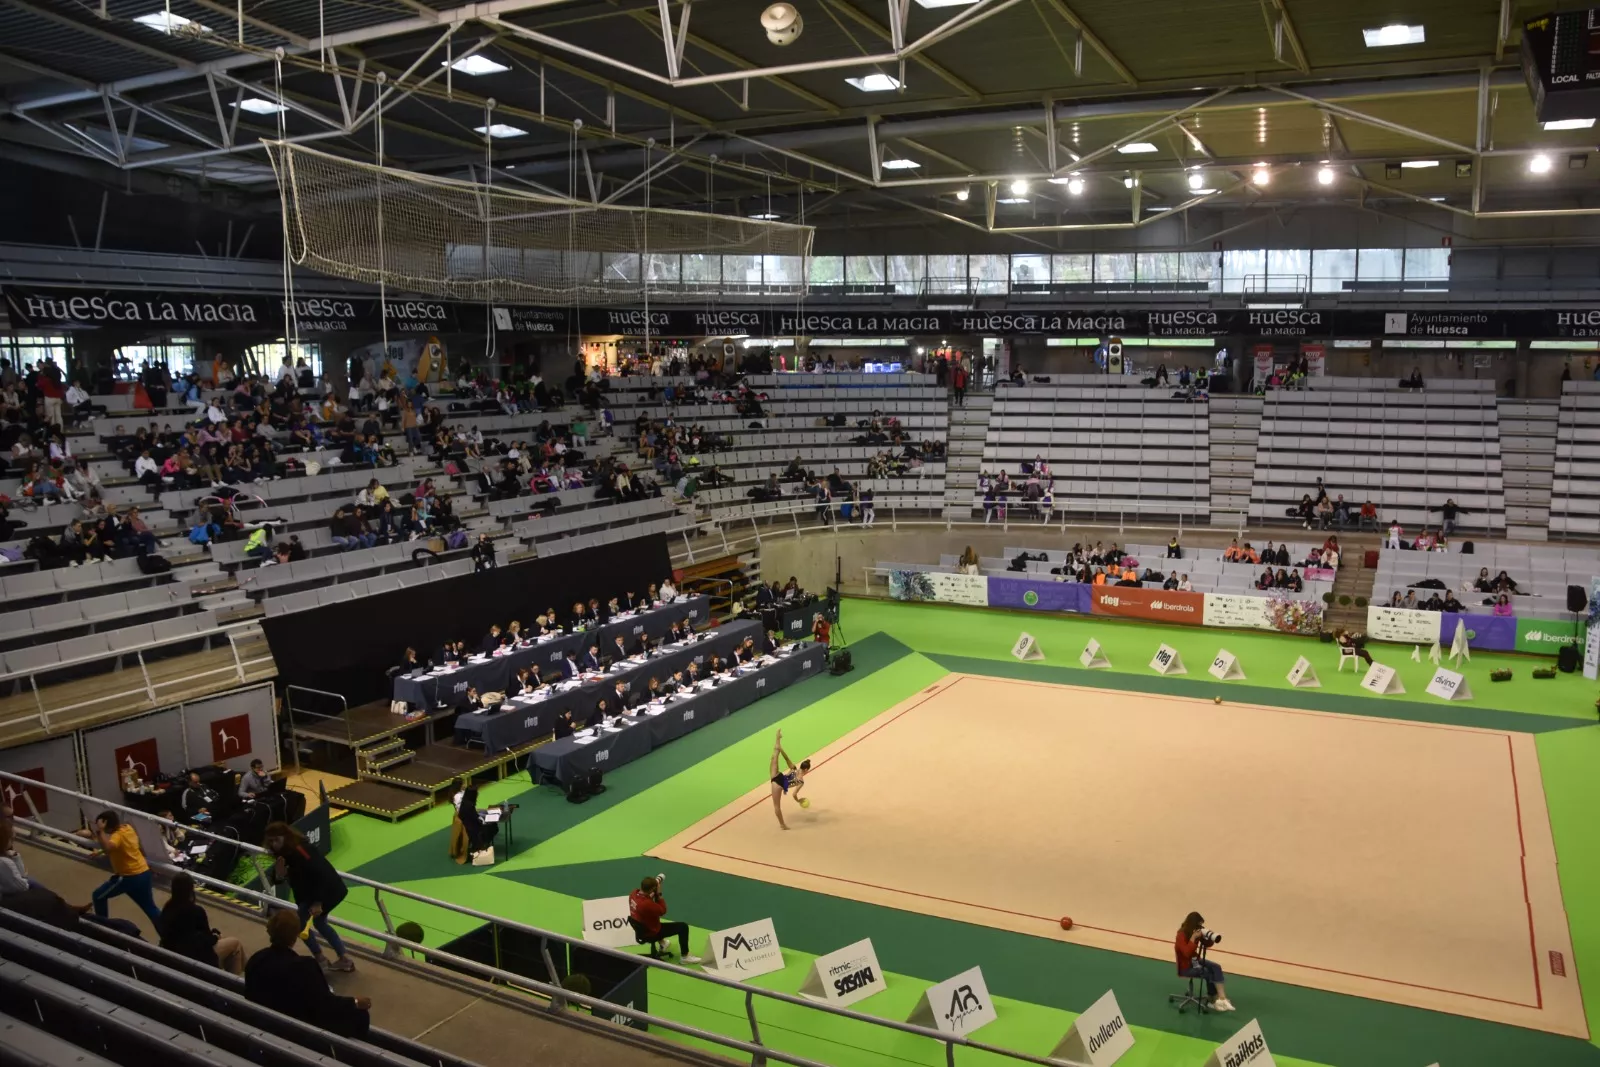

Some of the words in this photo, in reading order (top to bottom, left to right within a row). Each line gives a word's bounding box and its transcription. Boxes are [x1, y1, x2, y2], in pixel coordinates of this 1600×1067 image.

[1551, 74, 1580, 84] LOCAL
[512, 308, 564, 321] Ayuntamiento
[1411, 313, 1488, 324] Ayuntamiento
[514, 322, 525, 331] de
[525, 321, 555, 332] Huesca
[1410, 325, 1423, 334] de
[1426, 325, 1468, 335] Huesca
[1100, 594, 1119, 607] rfeg
[1163, 602, 1194, 613] Iberdrola
[1435, 675, 1456, 689] divina
[595, 749, 609, 763] rfeg
[1225, 1034, 1264, 1067] maillots
